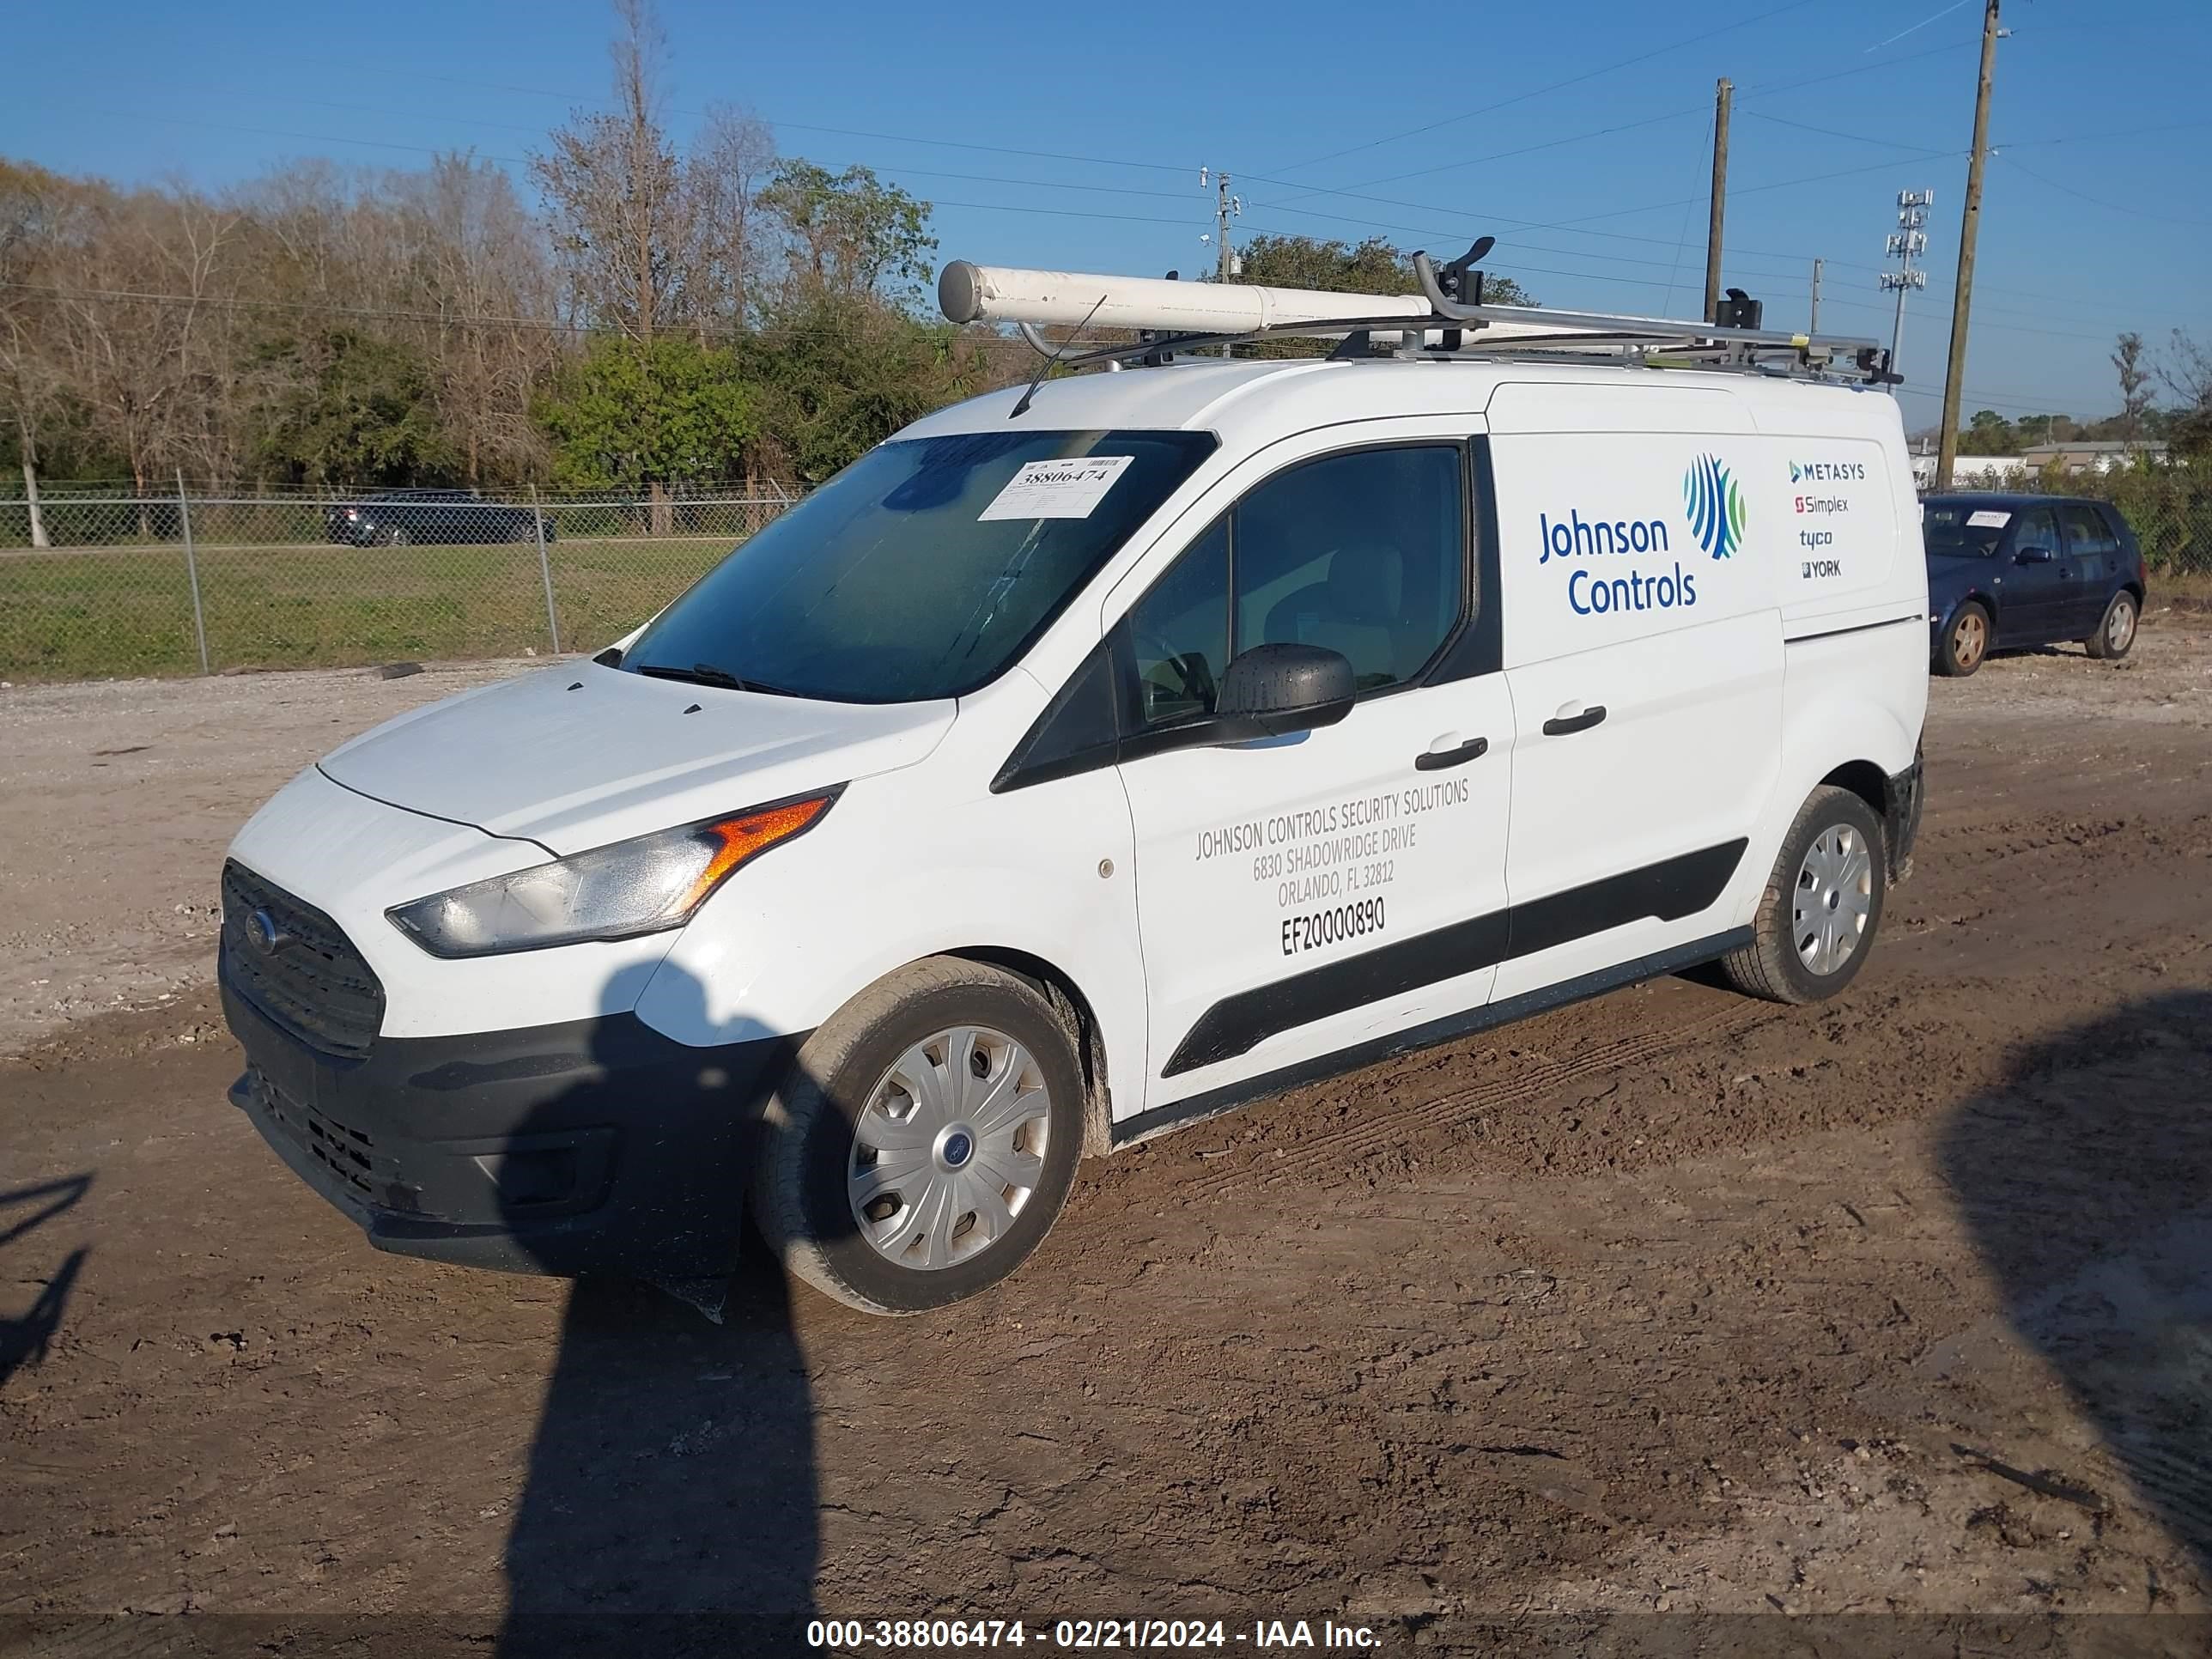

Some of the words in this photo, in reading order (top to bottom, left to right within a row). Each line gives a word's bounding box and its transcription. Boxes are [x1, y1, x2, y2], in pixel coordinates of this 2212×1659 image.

[1018, 470, 1109, 485] 38806474
[1804, 464, 1865, 480] METASYS
[1805, 495, 1848, 516] Simplex
[1540, 508, 1668, 564] Johnson
[1799, 530, 1832, 550] tyco
[1569, 562, 1696, 615] Controls
[1812, 560, 1841, 578] YORK
[1196, 822, 1262, 860] JOHNSON
[1267, 805, 1337, 845] CONTROLS
[1341, 793, 1400, 830] SECURITY
[1404, 778, 1469, 815] SOLUTIONS
[1253, 853, 1282, 881] 6830
[1286, 831, 1378, 874] SHADOWRIDGE
[1382, 823, 1416, 853] DRIVE
[1279, 871, 1342, 907] ORLANDO,
[1347, 867, 1359, 891] FL
[1364, 860, 1394, 888] 32812
[1282, 896, 1385, 956] EF20000890
